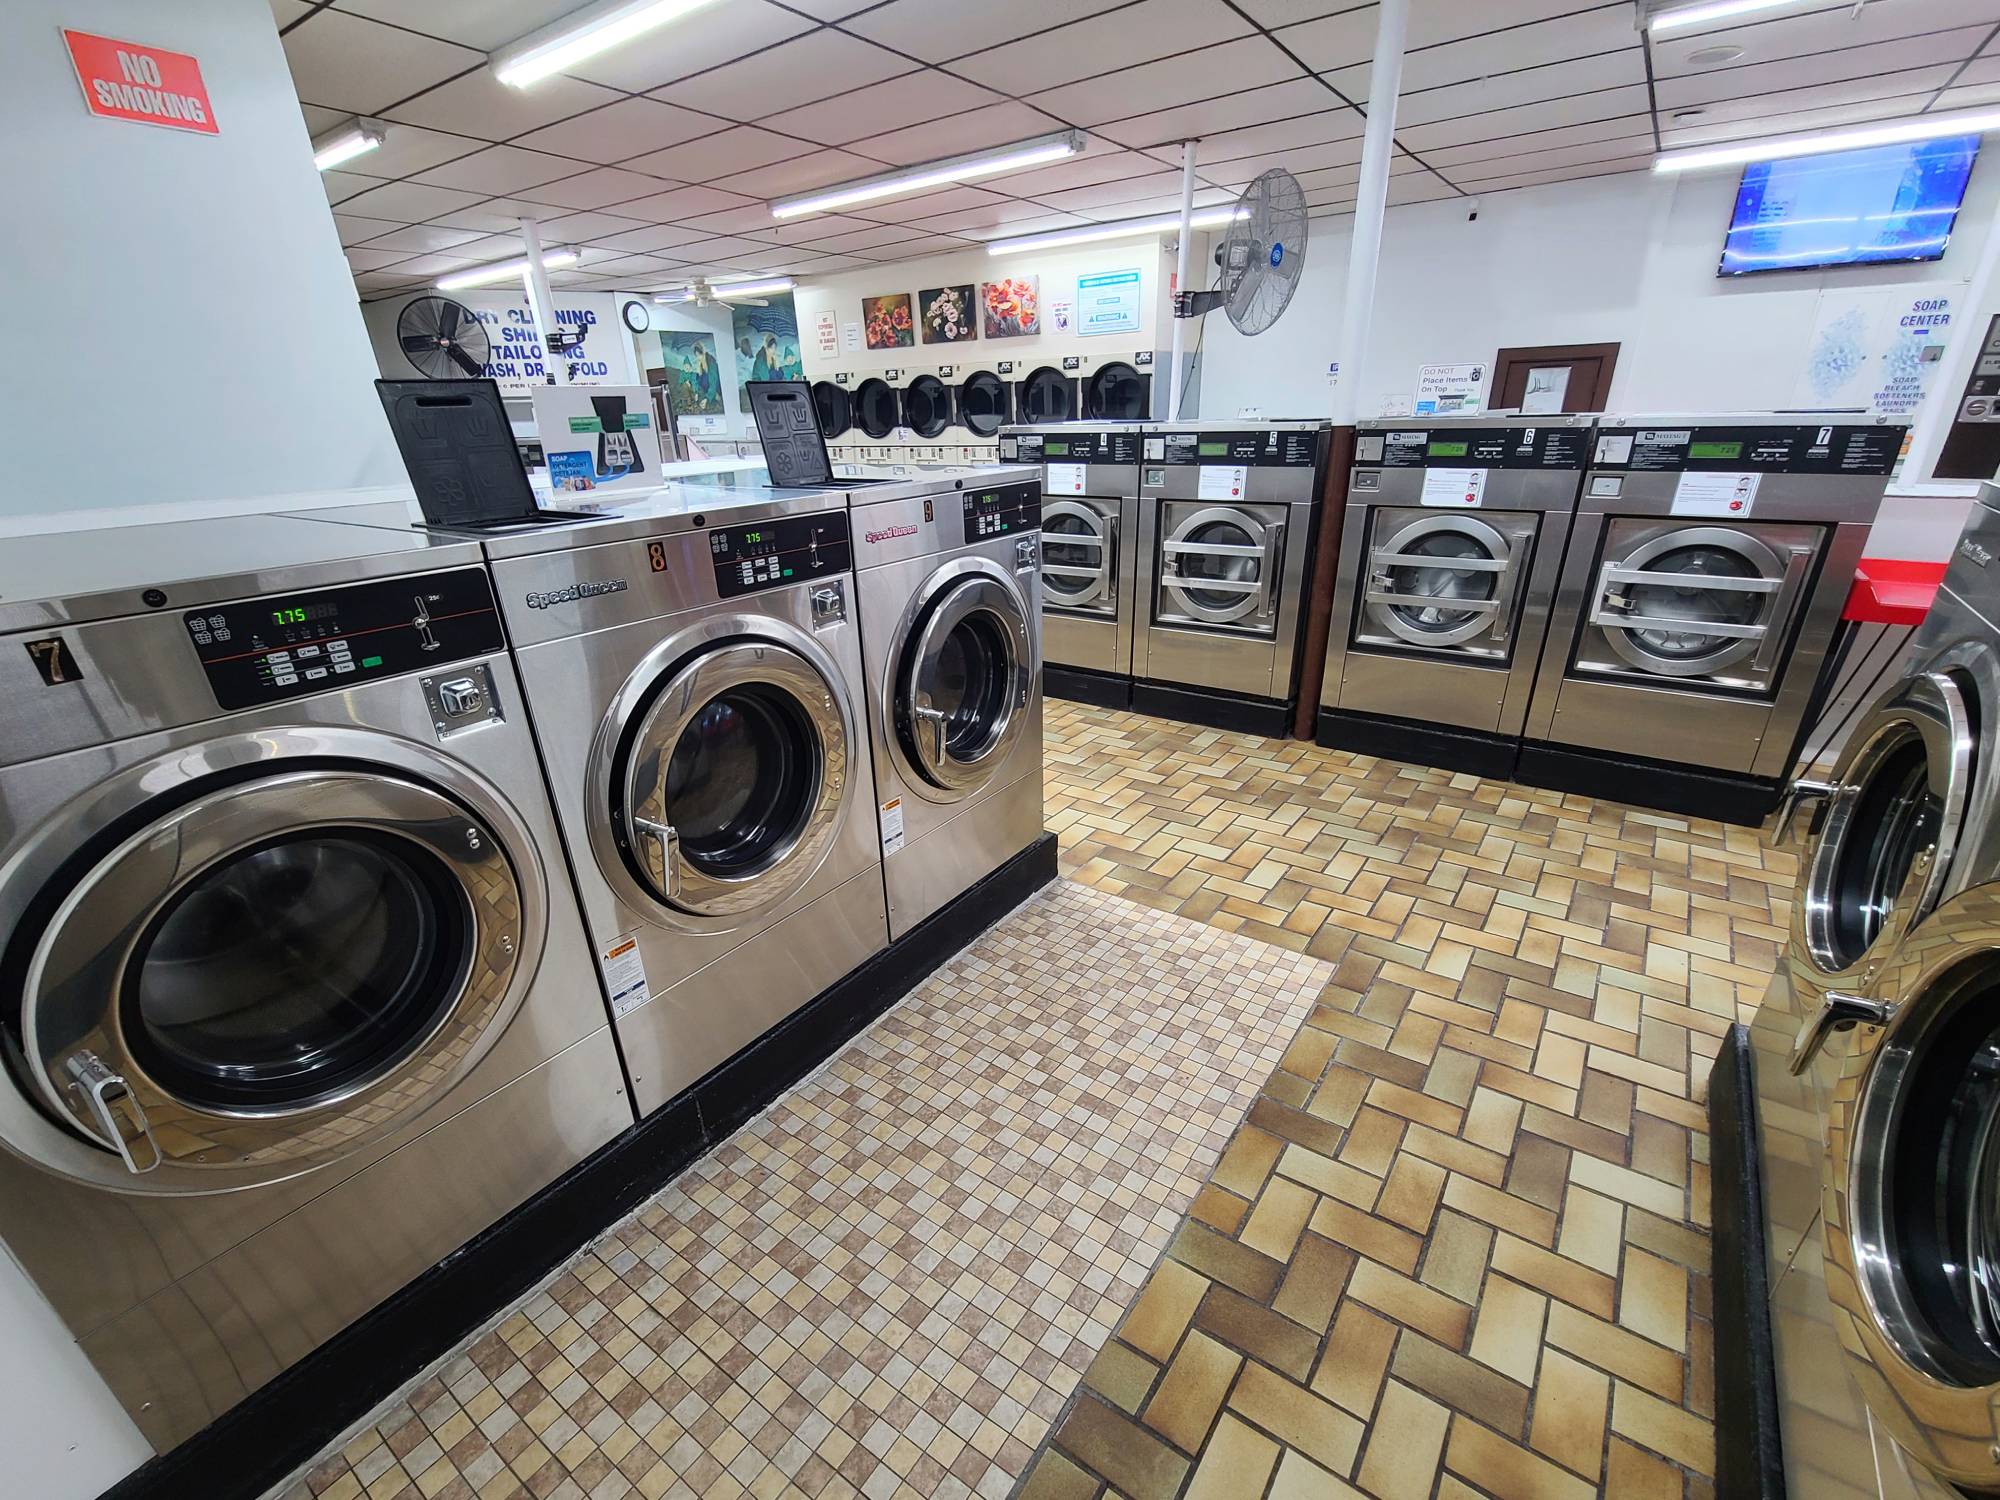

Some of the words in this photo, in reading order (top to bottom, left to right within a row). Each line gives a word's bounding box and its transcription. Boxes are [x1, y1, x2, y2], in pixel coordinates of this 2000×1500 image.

[116, 50, 162, 88] NO
[93, 78, 207, 124] SMOKING
[1912, 299, 1948, 312] SOAP
[463, 309, 499, 325] DRY
[1900, 314, 1951, 327] CENTER
[525, 363, 547, 377] DR
[1422, 377, 1444, 385] Place
[1434, 385, 1448, 393] Top
[1270, 432, 1277, 445] 5
[1525, 430, 1534, 443] 6
[1820, 428, 1831, 443] 7
[924, 502, 933, 521] 9
[866, 527, 893, 543] Speed
[892, 524, 918, 537] Queen
[650, 543, 665, 571] 8
[527, 586, 580, 609] Speed
[578, 579, 627, 598] Queen
[31, 640, 65, 683] 7
